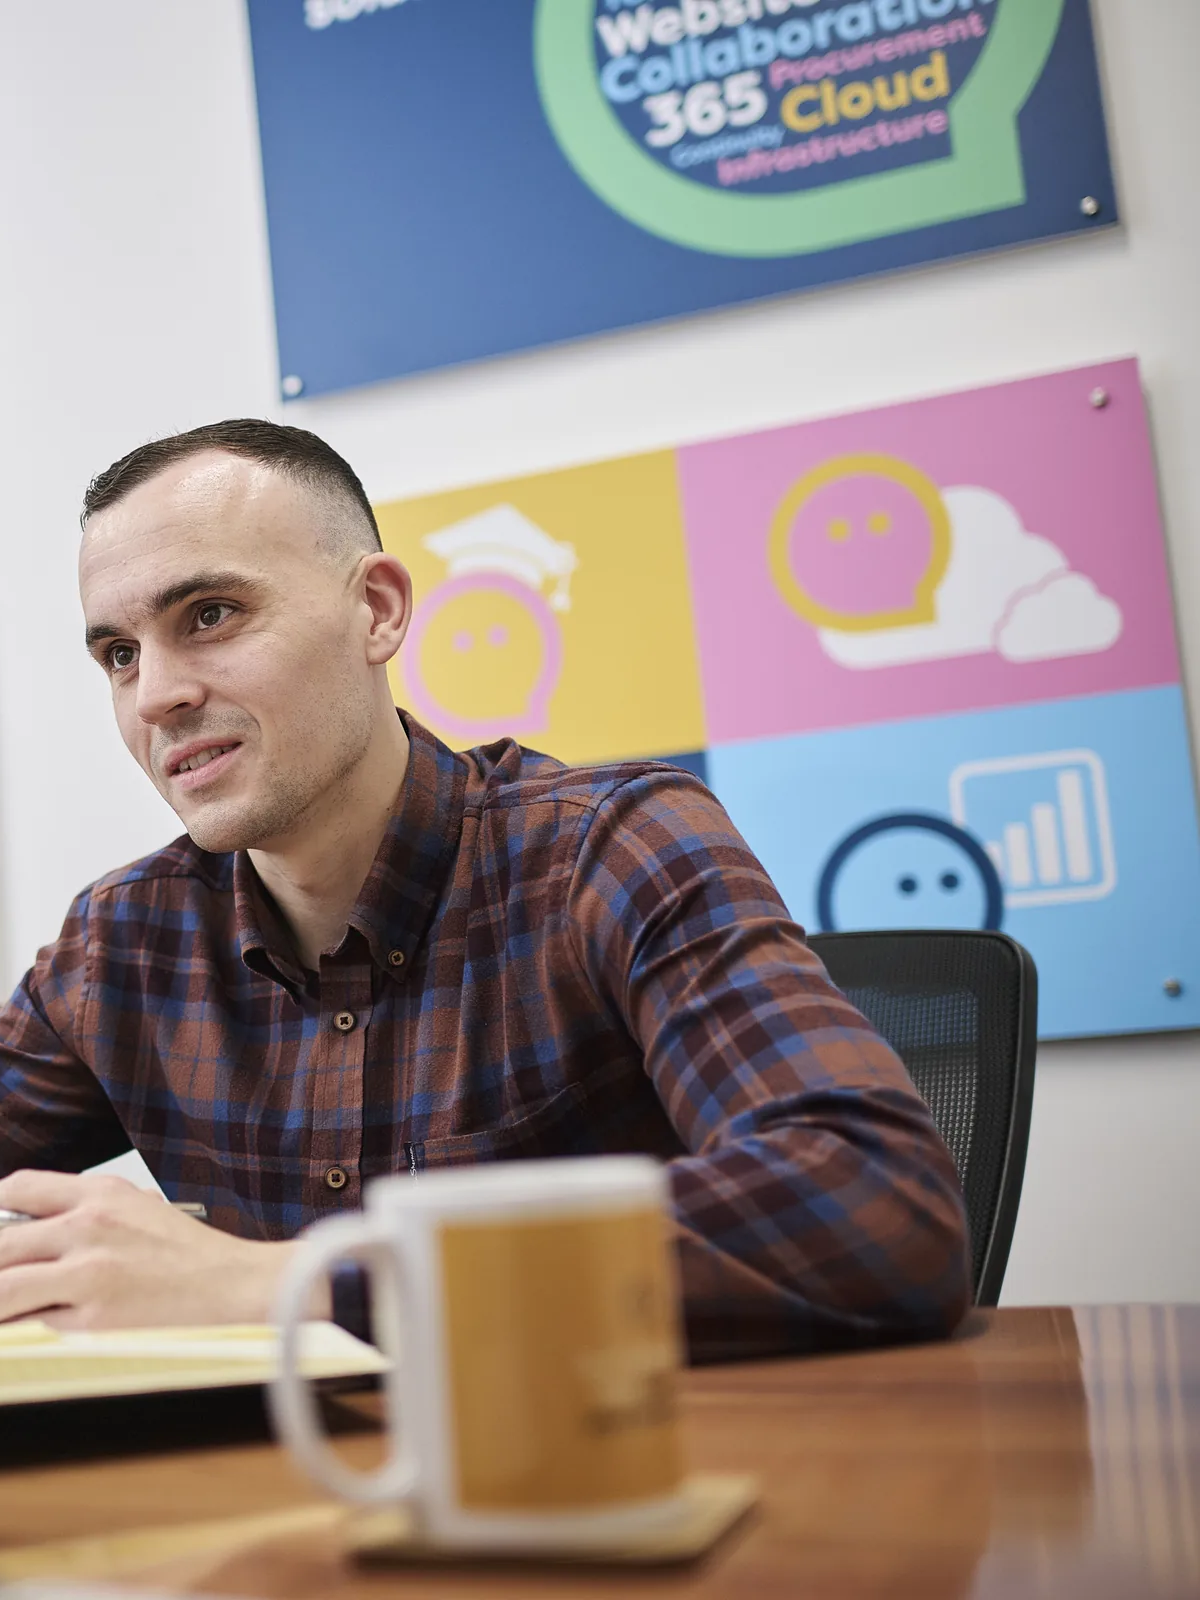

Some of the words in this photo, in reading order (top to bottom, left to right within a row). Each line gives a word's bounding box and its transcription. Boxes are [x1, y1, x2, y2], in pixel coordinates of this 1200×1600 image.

[596, 0, 821, 57] Webs
[768, 11, 987, 90] Procurement
[642, 70, 768, 147] 365
[780, 50, 949, 132] Cloud
[717, 110, 949, 185] Infrastructure
